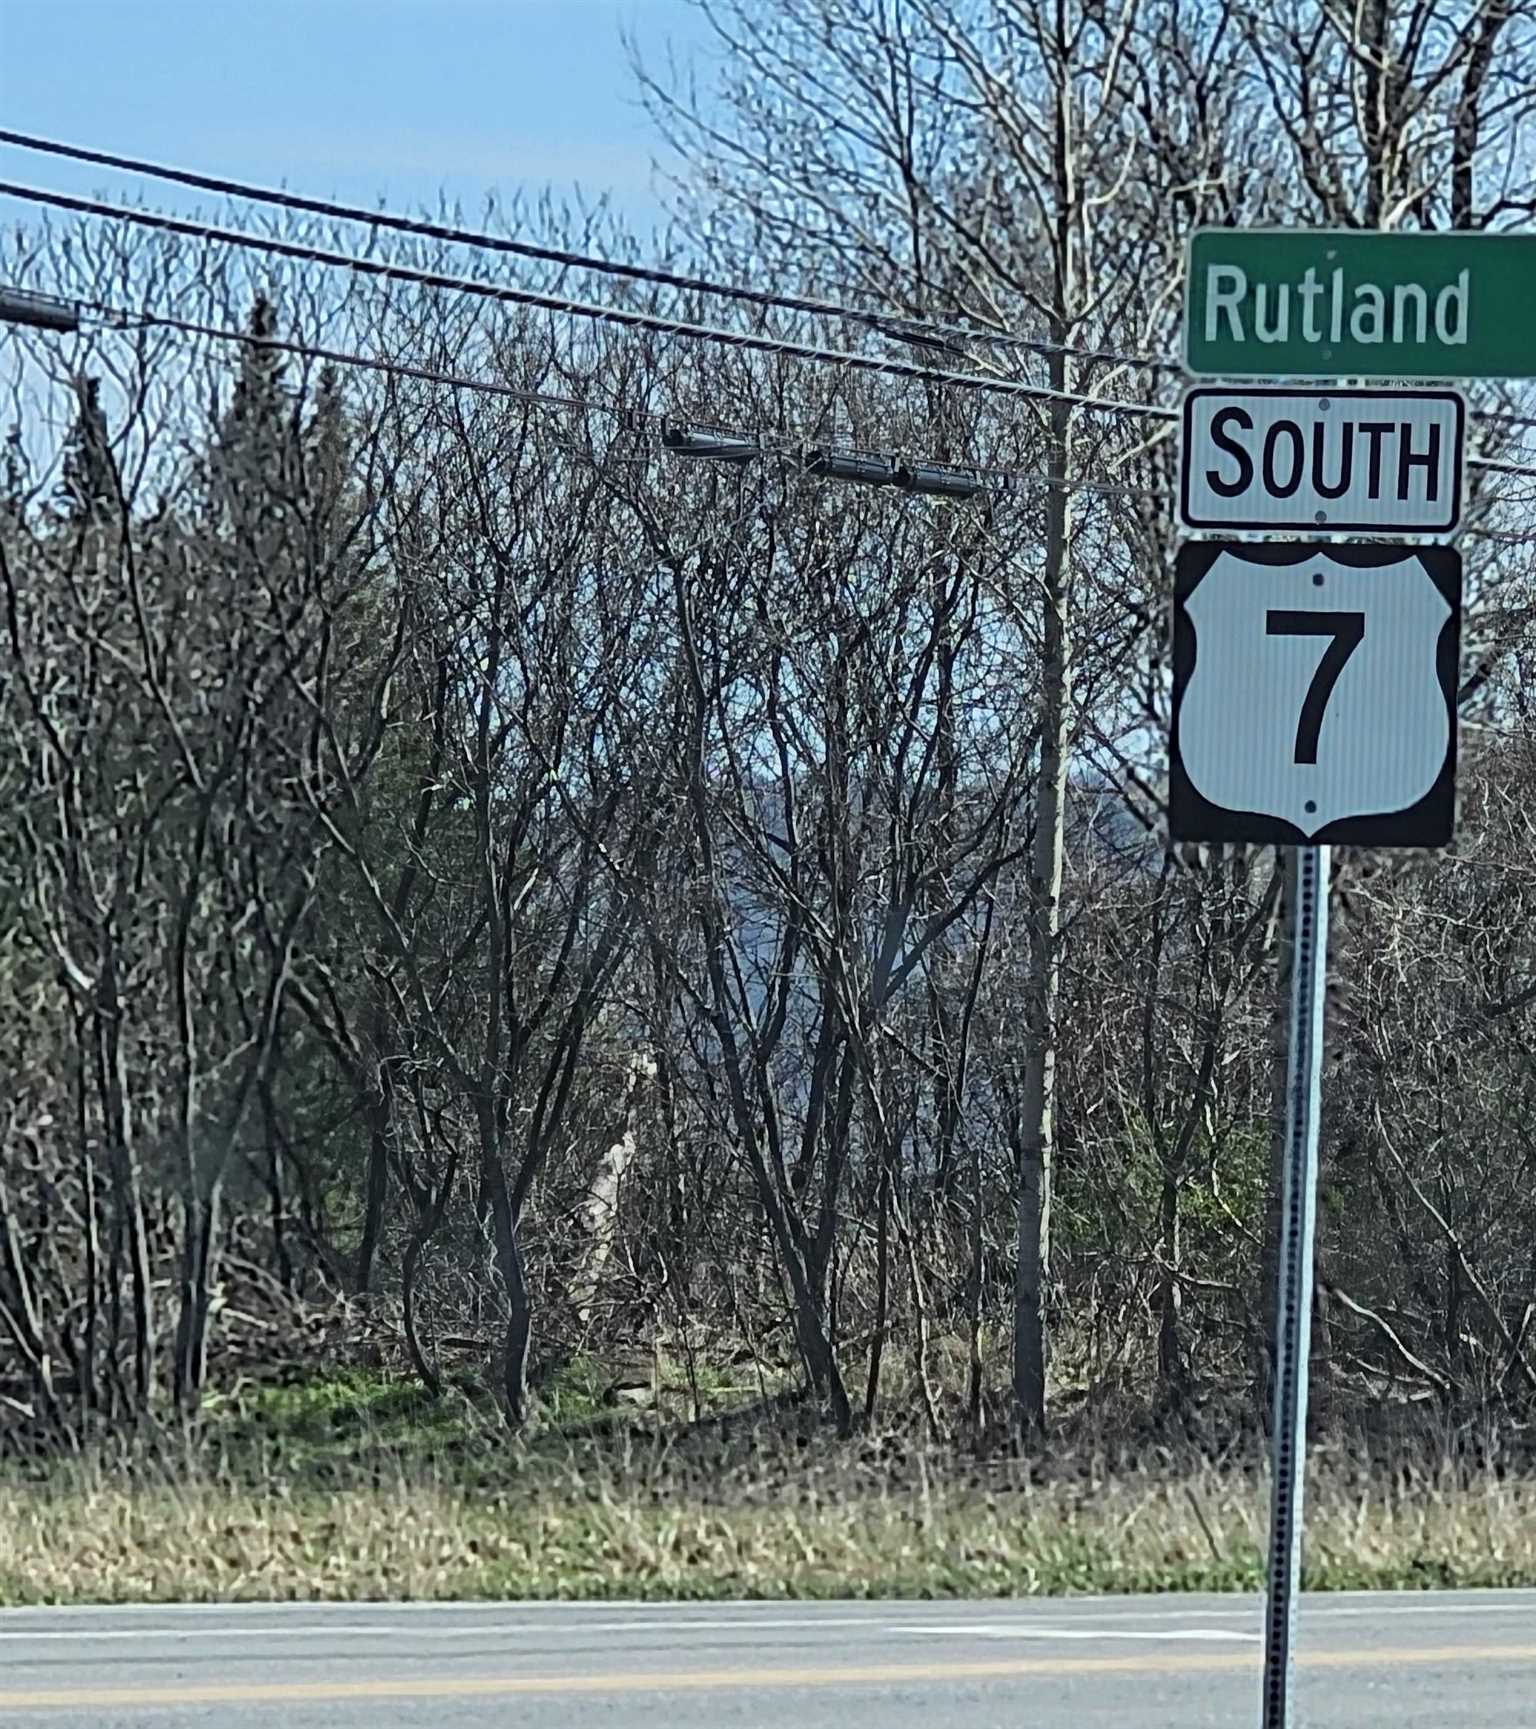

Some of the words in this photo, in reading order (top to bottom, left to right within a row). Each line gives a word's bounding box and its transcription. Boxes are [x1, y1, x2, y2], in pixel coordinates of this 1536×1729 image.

[1205, 263, 1469, 345] Rutland
[1206, 406, 1440, 501] SOUTH
[1266, 609, 1365, 765] 7
